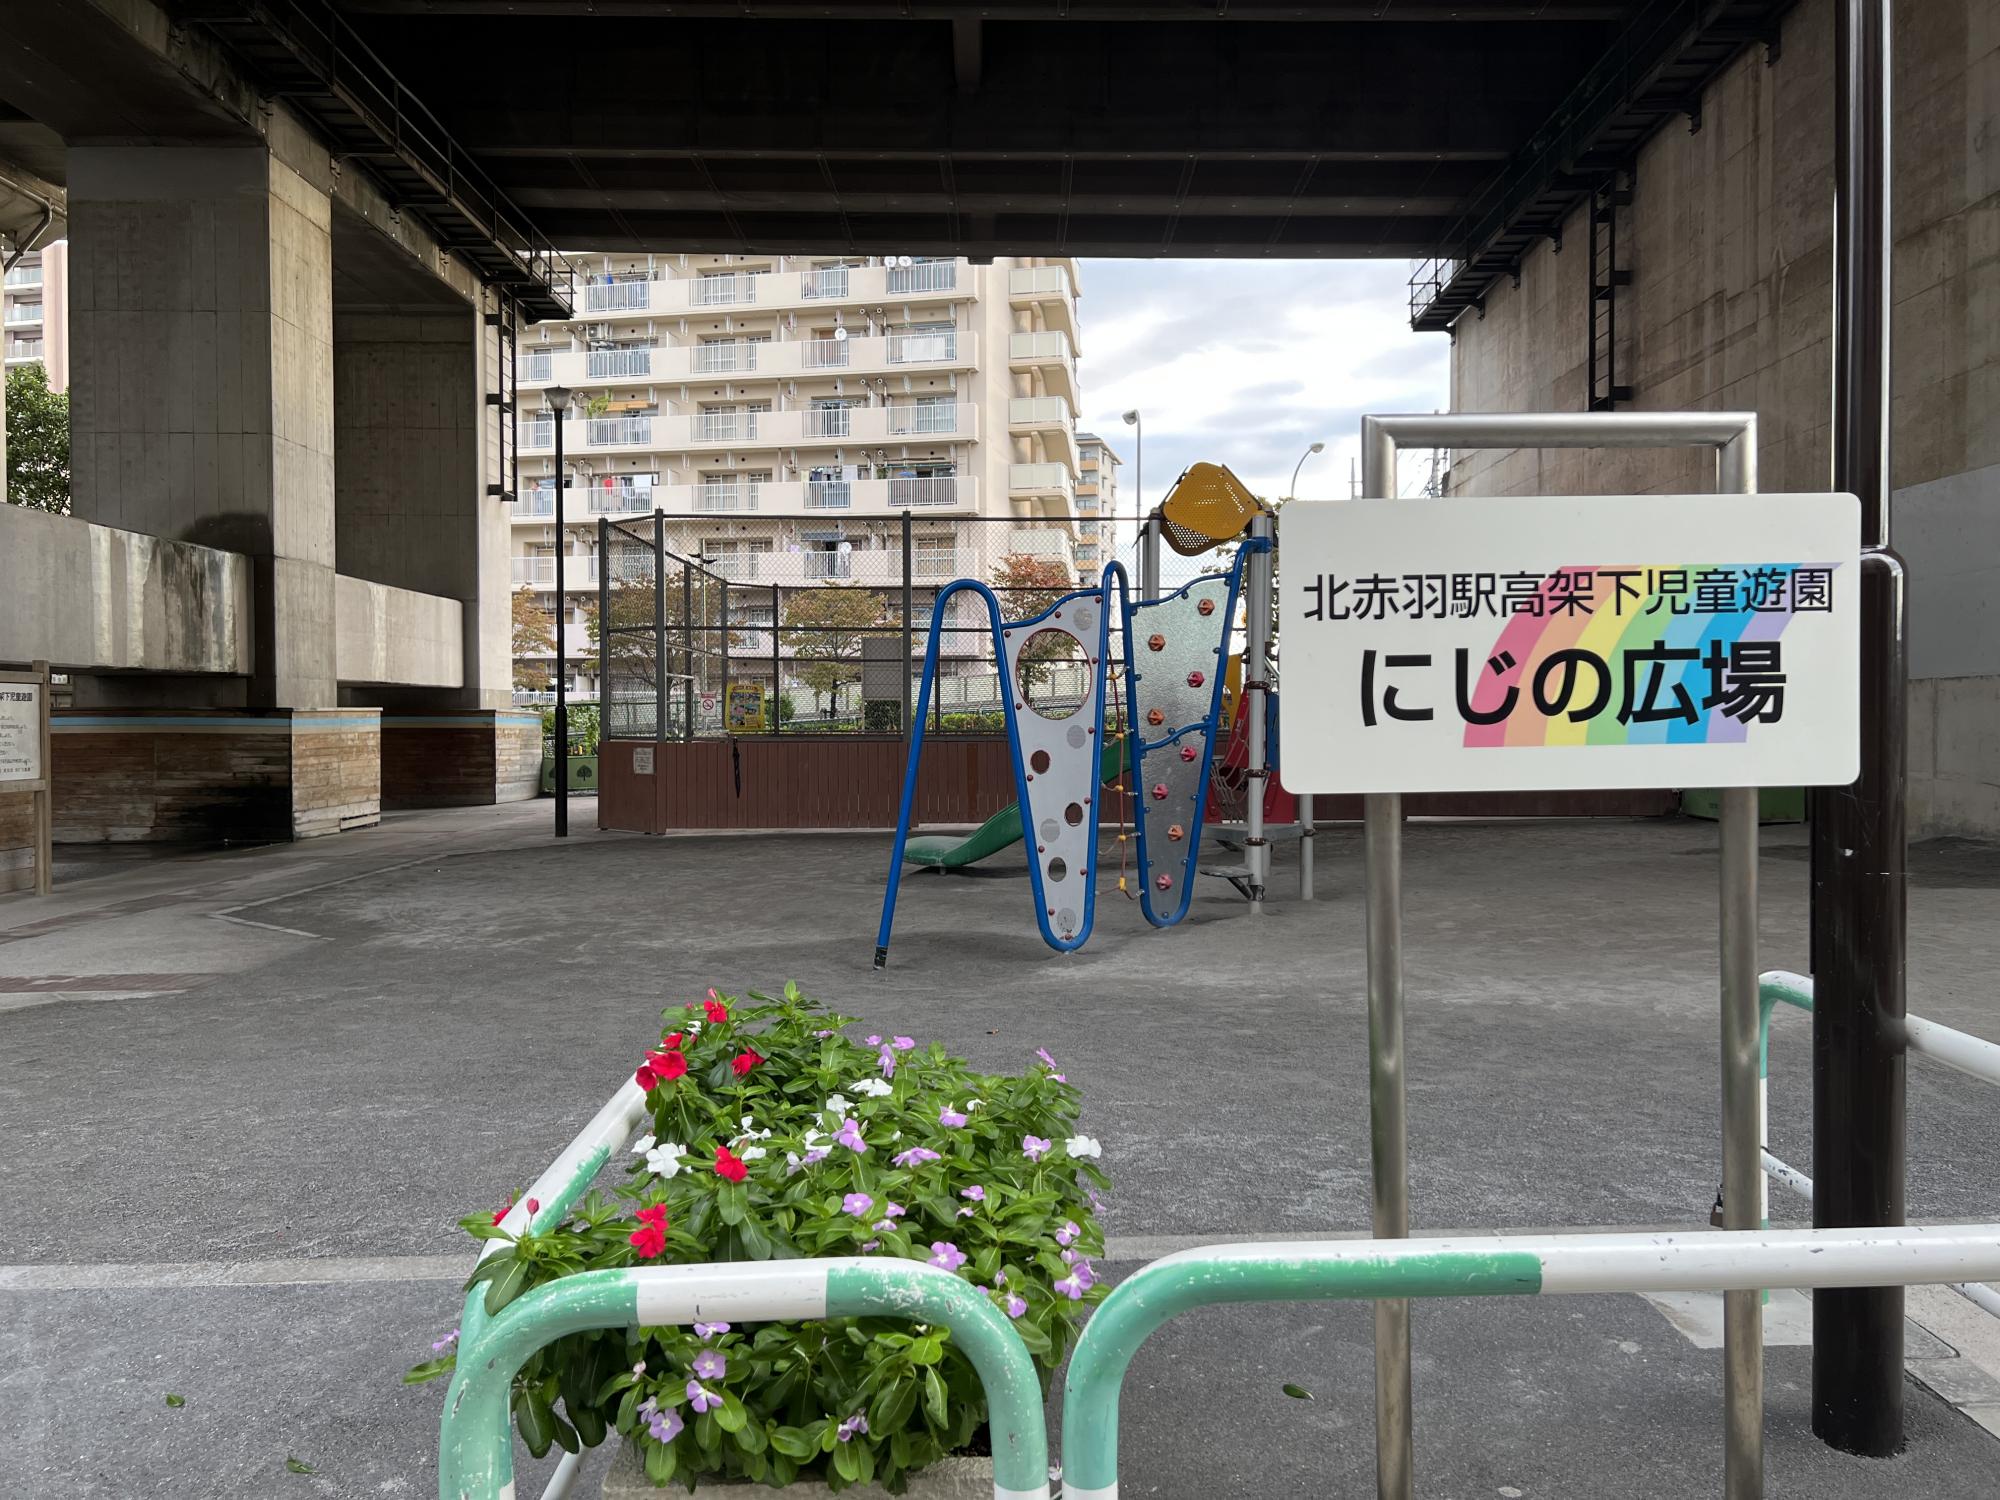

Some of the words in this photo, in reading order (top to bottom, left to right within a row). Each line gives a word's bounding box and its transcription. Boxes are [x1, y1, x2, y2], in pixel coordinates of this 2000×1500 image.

[1303, 567, 1833, 621] 北赤羽駅高架下児童遊園
[1361, 639, 1787, 727] にじの広場
